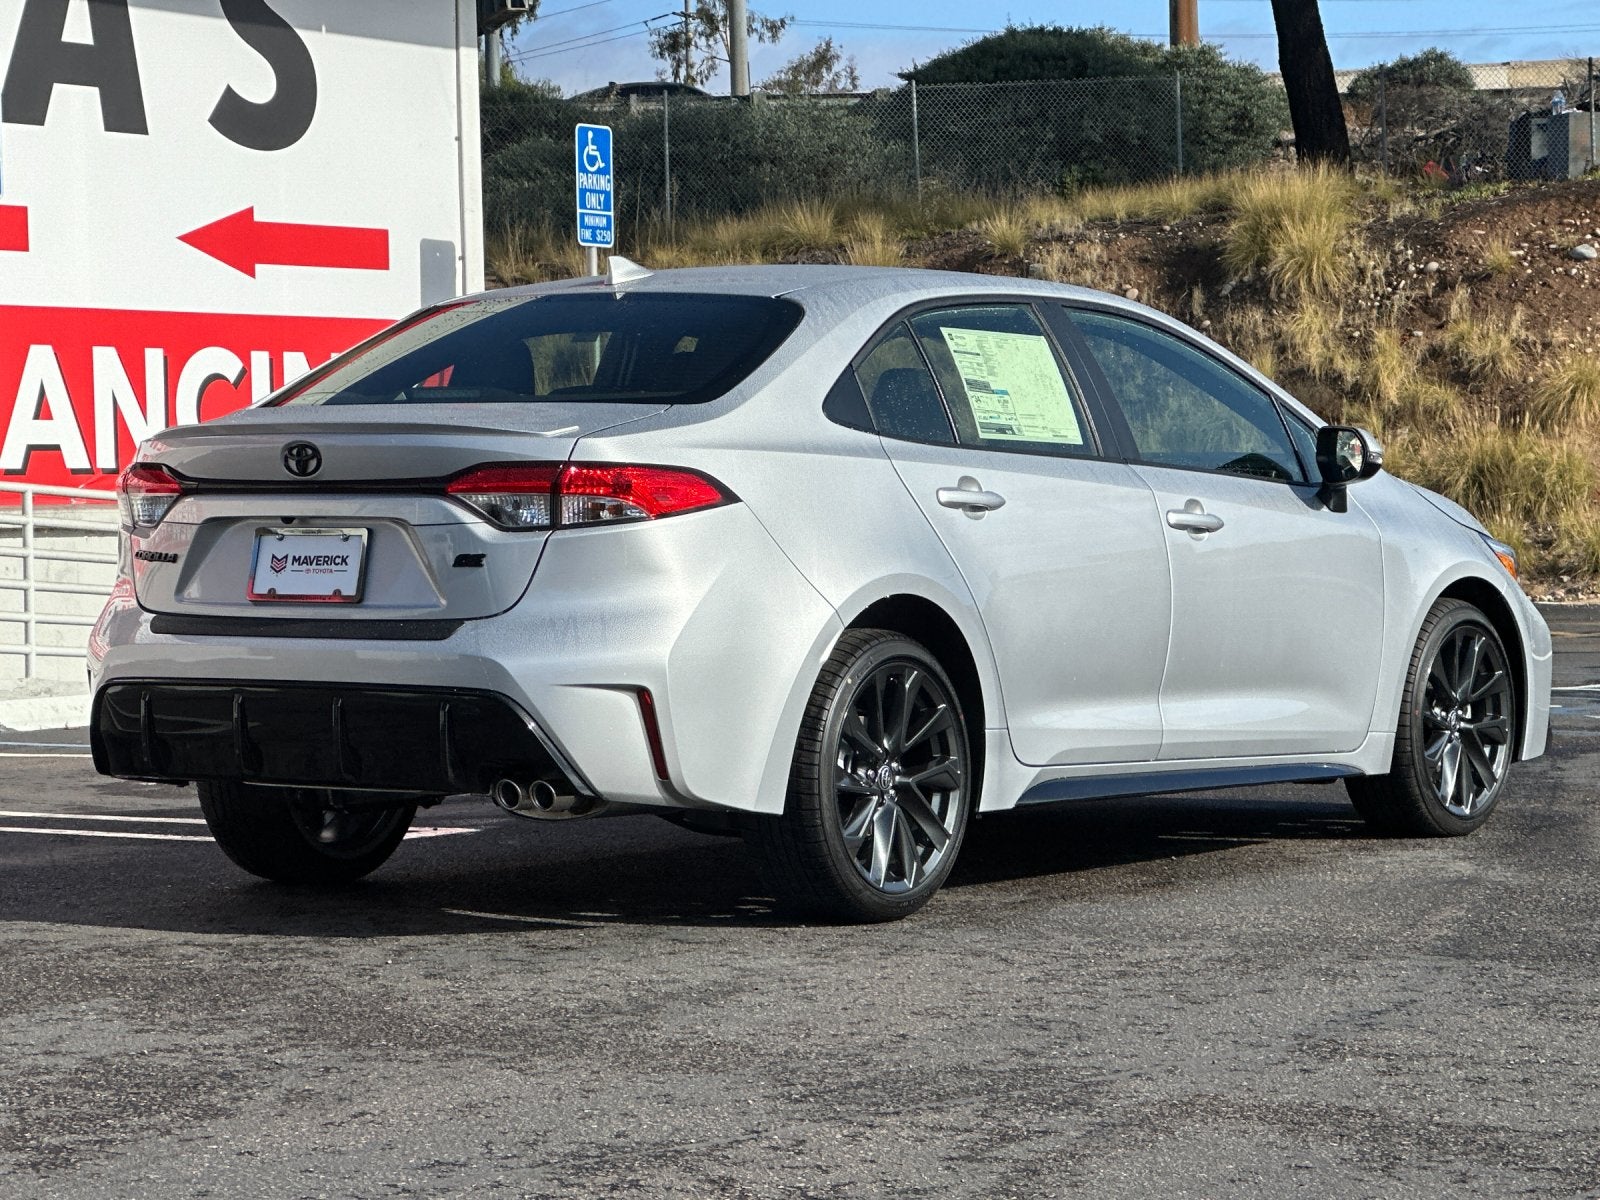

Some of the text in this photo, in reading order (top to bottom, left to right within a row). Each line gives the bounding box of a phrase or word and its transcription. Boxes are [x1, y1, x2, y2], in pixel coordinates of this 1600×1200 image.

[579, 172, 611, 191] PARKING
[585, 192, 605, 209] ONLY
[584, 215, 607, 228] MINIMUM
[581, 228, 611, 242] FINE $250
[291, 555, 350, 567] MAVERICK
